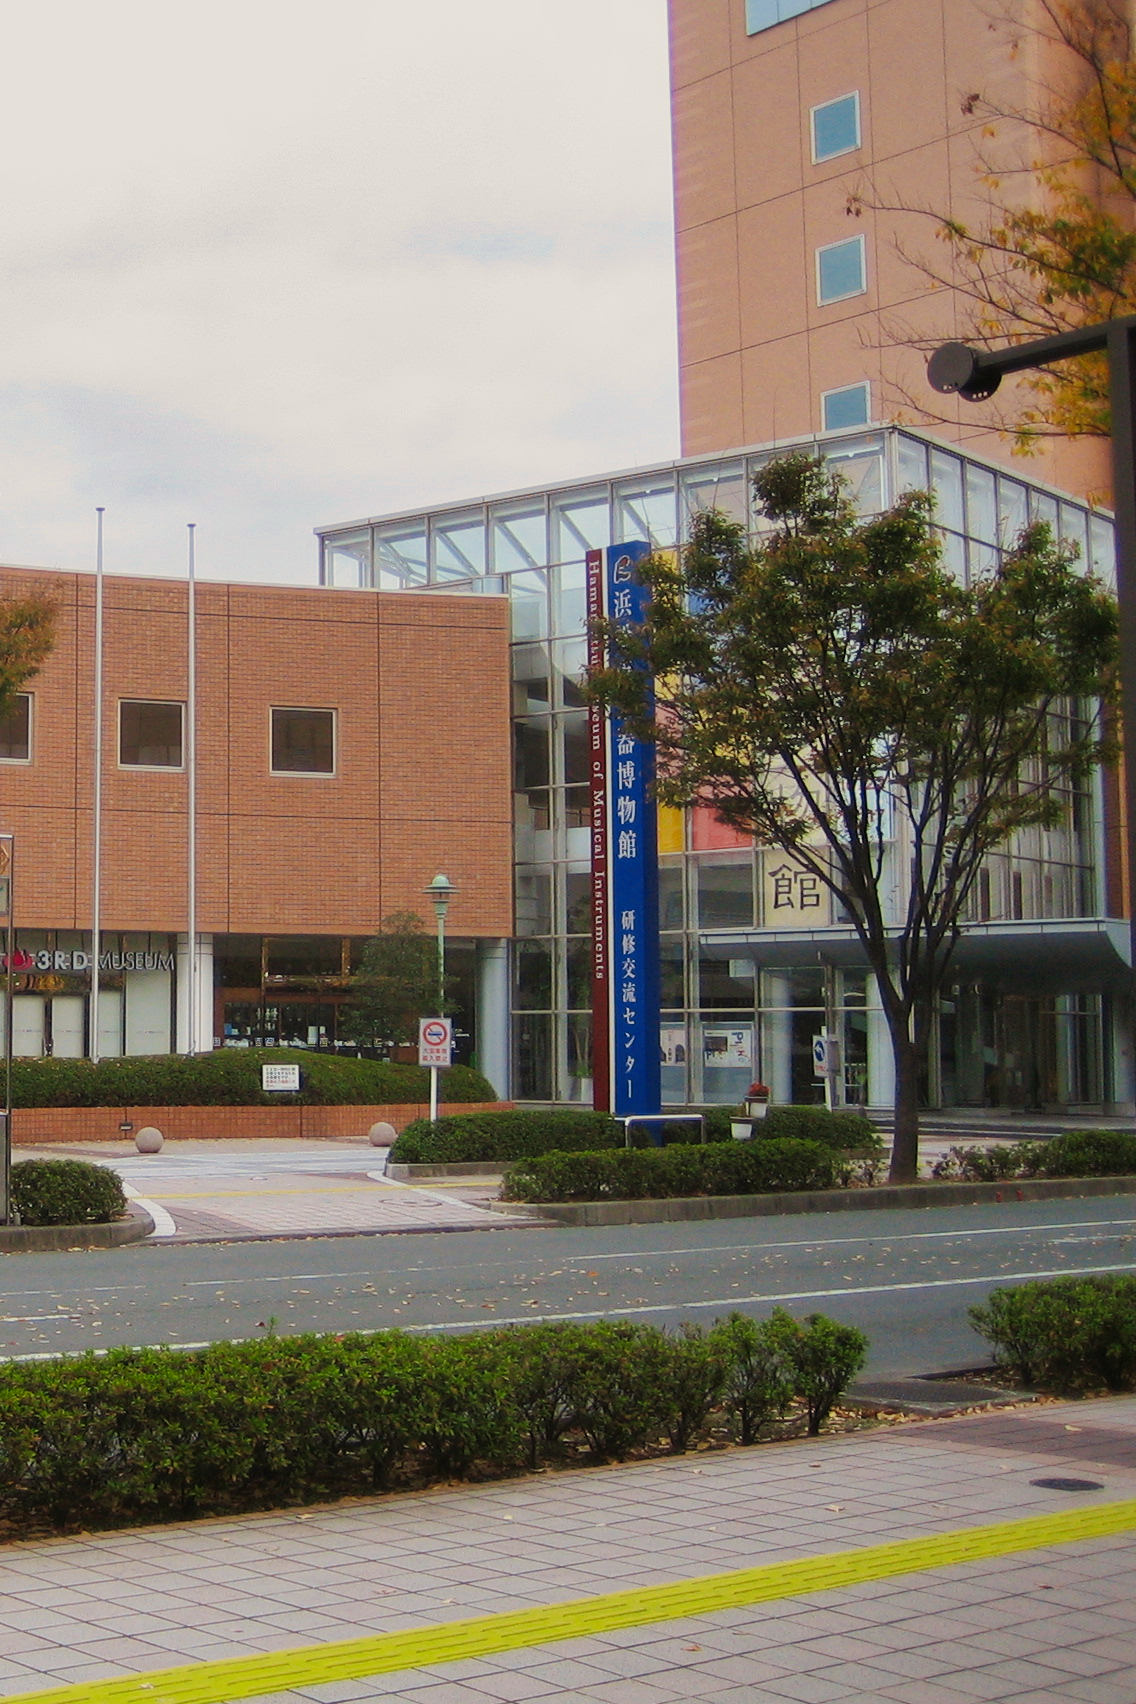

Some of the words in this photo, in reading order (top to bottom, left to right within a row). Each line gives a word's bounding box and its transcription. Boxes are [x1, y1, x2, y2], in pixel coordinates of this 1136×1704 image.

[592, 761, 604, 780] of
[592, 790, 605, 860] Musical
[36, 949, 89, 971] 3RD
[96, 950, 175, 972] MUSEUM
[593, 871, 606, 980] Instruments
[621, 909, 637, 1098] 研修交流センター
